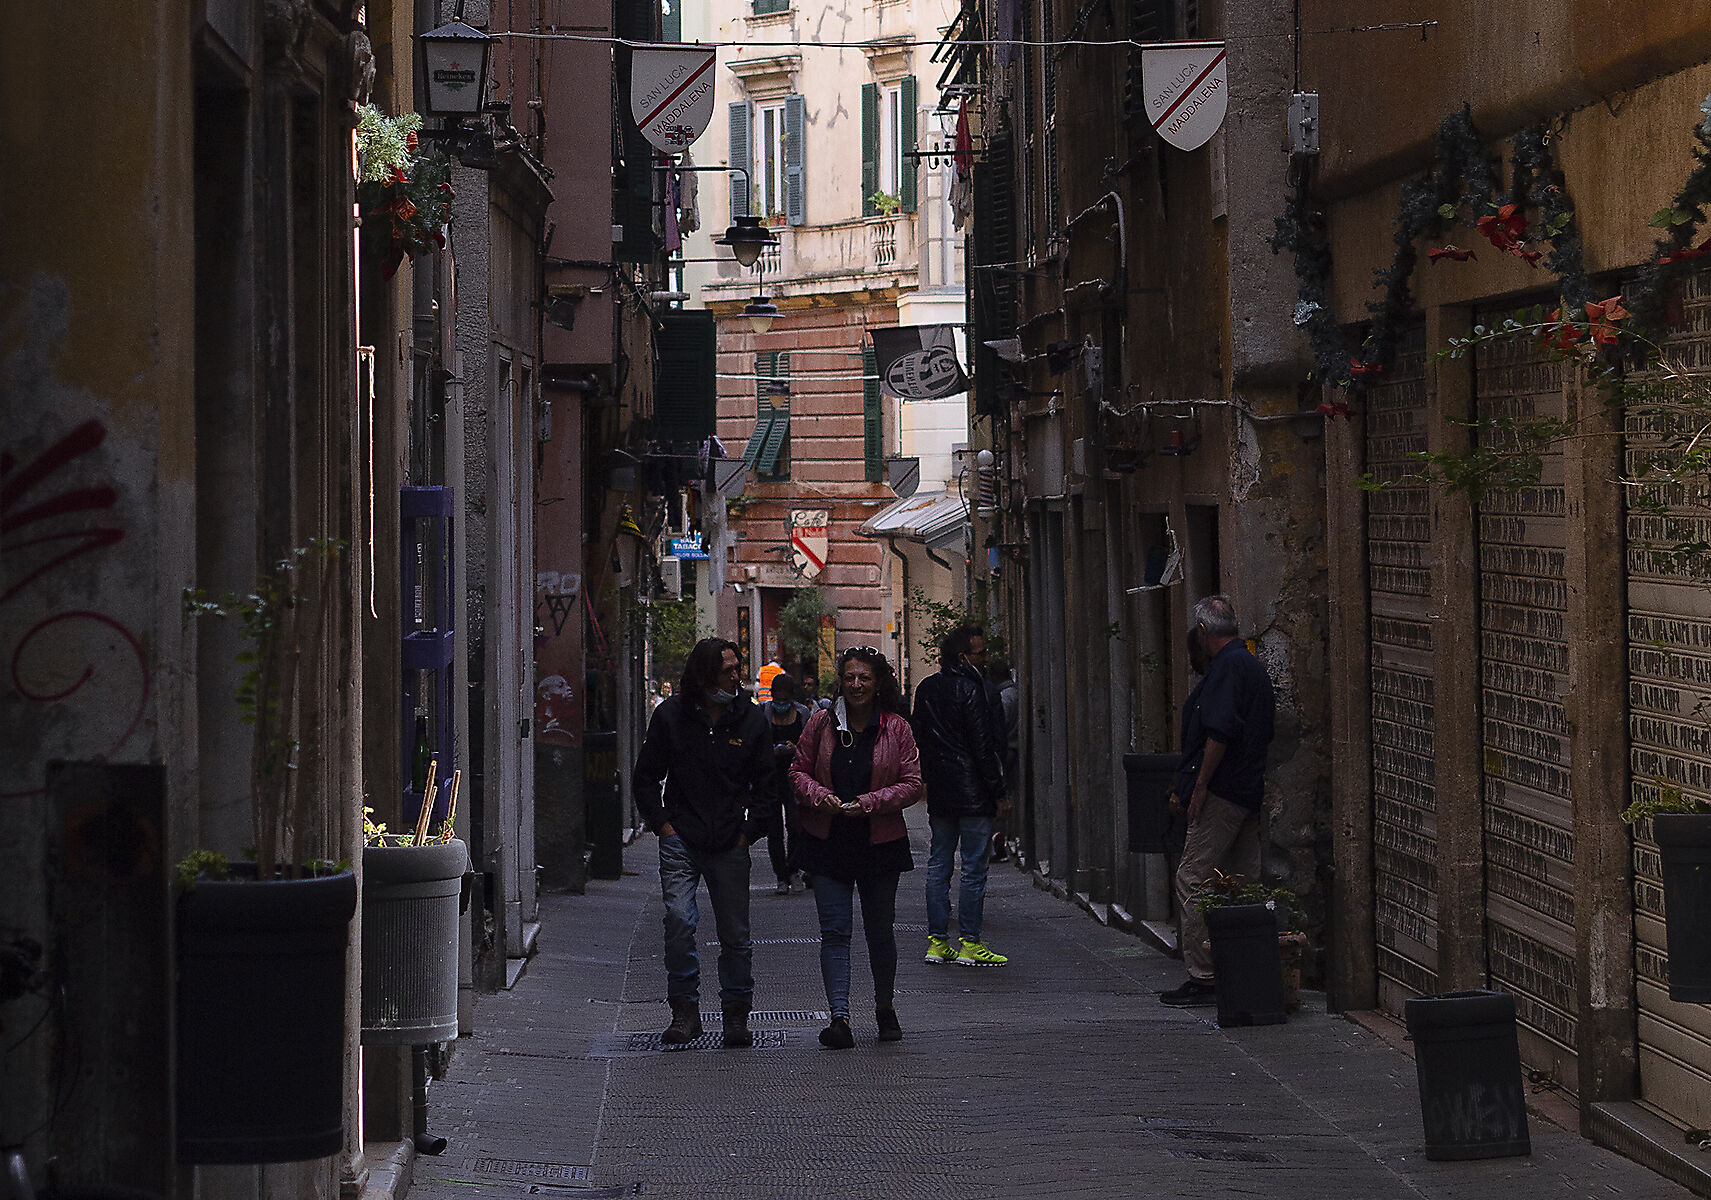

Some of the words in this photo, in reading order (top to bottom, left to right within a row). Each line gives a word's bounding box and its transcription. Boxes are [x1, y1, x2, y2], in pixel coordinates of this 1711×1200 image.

[640, 88, 661, 109] SAN
[659, 64, 688, 90] LUCA
[652, 81, 712, 136] MADDALENA
[1152, 86, 1174, 109] SAN
[1170, 63, 1198, 89] LUCA
[1167, 77, 1224, 135] MADDALENA
